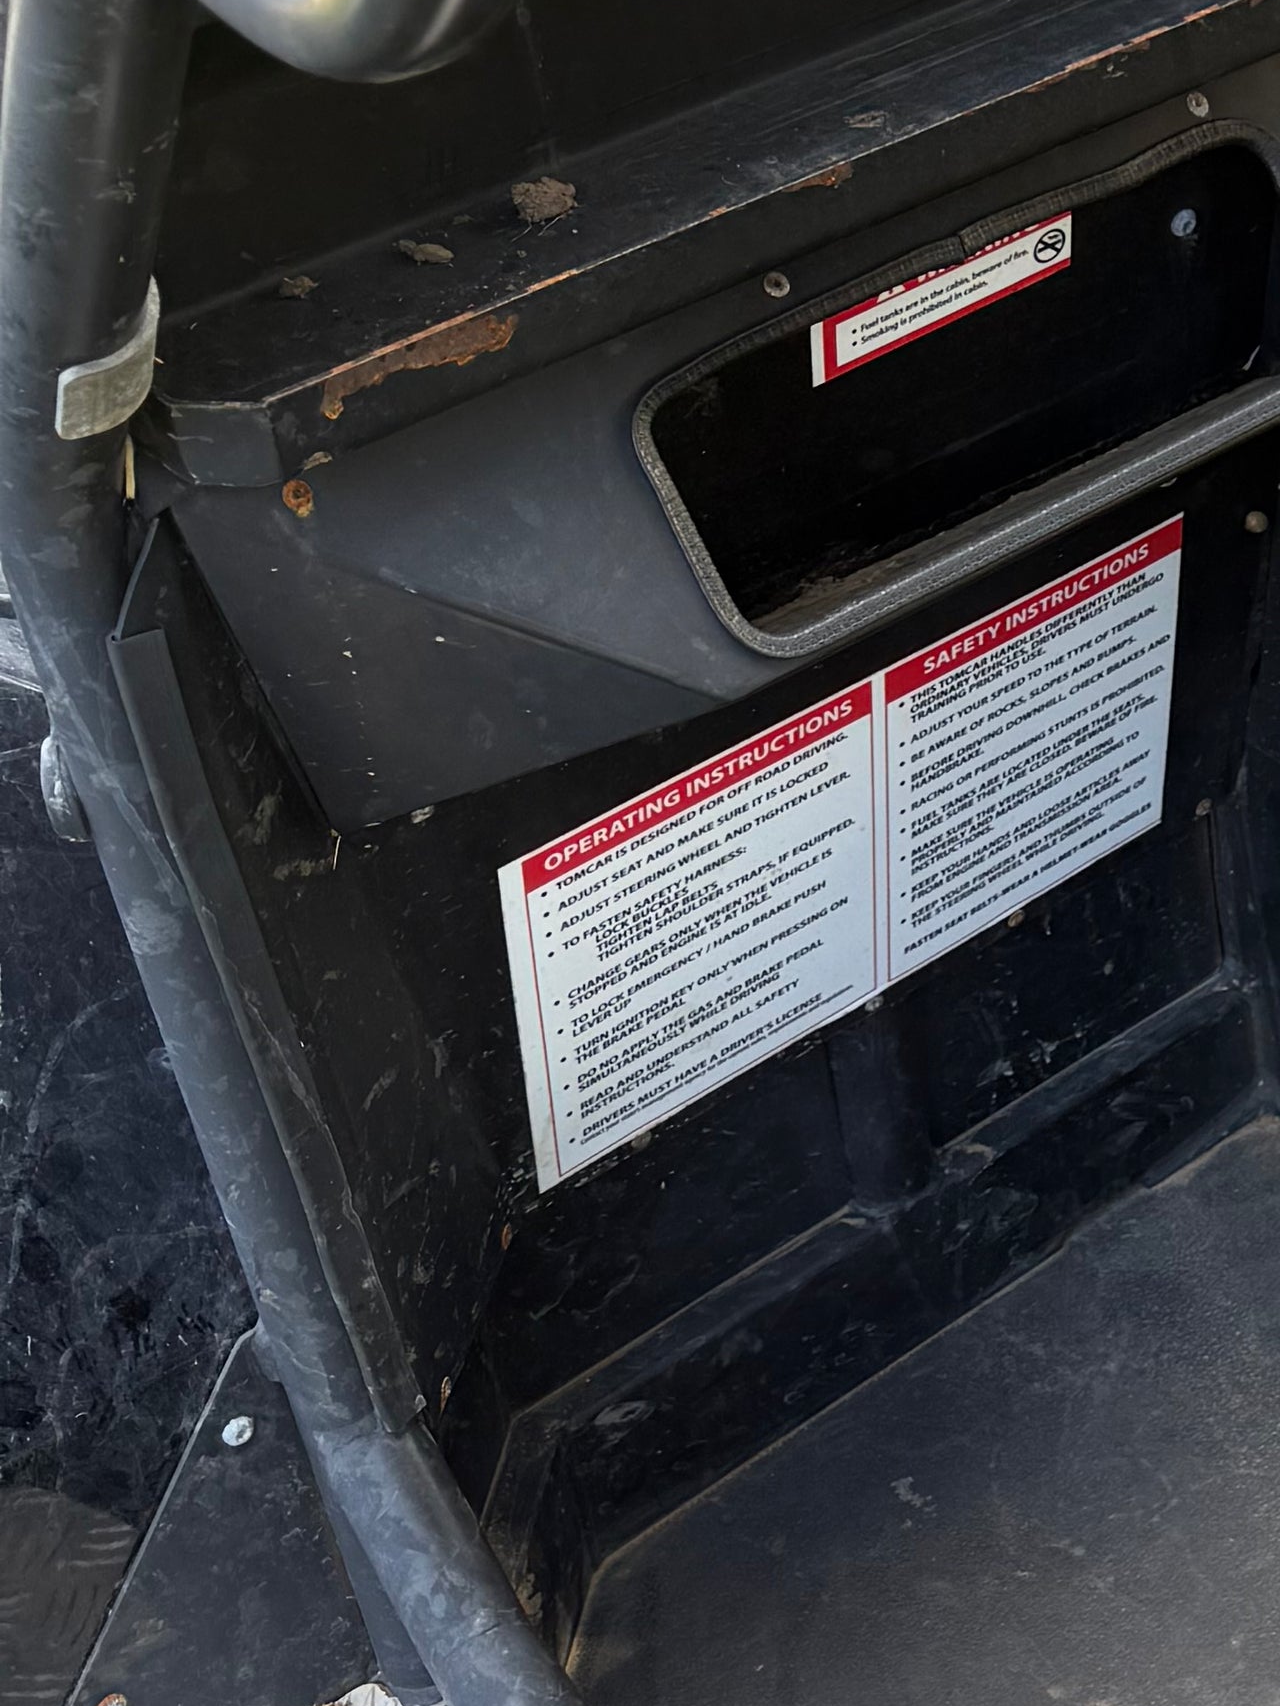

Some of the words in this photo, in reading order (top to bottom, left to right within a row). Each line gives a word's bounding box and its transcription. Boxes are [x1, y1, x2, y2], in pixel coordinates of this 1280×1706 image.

[860, 316, 879, 332] Fuel
[879, 307, 903, 323] tanks
[904, 300, 918, 311] are
[919, 295, 929, 304] in
[929, 288, 944, 299] the
[971, 260, 1002, 280] beware
[1002, 253, 1012, 265] of
[860, 321, 899, 345] Smoking
[899, 317, 907, 326] is
[908, 294, 953, 323] prohibited
[953, 291, 962, 300] in
[909, 675, 970, 713] ORDINARY
[1030, 619, 1077, 650] DRIVERS
[1078, 600, 1110, 624] MUST
[1111, 571, 1164, 606] UNDERGO
[910, 683, 937, 703] THIS
[938, 656, 987, 688] TOMCAR
[989, 627, 1043, 662] HANDLES
[1044, 588, 1114, 633] DIFFERENTLY
[1115, 571, 1146, 594] THAN
[910, 713, 954, 744] ADJUST
[956, 695, 988, 718] YOUR
[990, 676, 1026, 701] SPEED
[1027, 666, 1042, 680] TO
[1043, 654, 1064, 671] THE
[1066, 638, 1092, 659] TYPE
[1093, 629, 1109, 644] OF
[1110, 604, 1157, 635] TERRAIN.
[923, 621, 1000, 674] SAFETY
[1005, 542, 1148, 631] INSTRUCTIONS
[910, 687, 967, 723] TRAINING
[968, 668, 1003, 693] PRIOR
[1004, 659, 1020, 673] TO
[1021, 646, 1046, 664] USE.
[910, 749, 925, 763] BE
[927, 726, 967, 754] AWARE
[969, 716, 984, 731] OF
[1029, 670, 1069, 699] SLOPES
[1070, 656, 1095, 676] AND
[1096, 635, 1136, 662] BUMPS.
[910, 752, 954, 782] BEFORE
[956, 725, 1004, 757] DRIVING
[1068, 669, 1104, 695] CHECK
[1105, 646, 1146, 675] BRAKES
[1147, 633, 1171, 652] AND
[543, 788, 680, 870] OPERATING
[685, 699, 852, 797] INSTRUCTIONS
[555, 853, 612, 890] TOMCAR
[614, 845, 627, 859] IS
[629, 810, 696, 851] DESIGNED
[698, 794, 724, 815] FOR
[726, 780, 751, 799] OFF
[753, 760, 791, 785] ROAD
[792, 731, 848, 765] DRIVING.
[557, 876, 607, 911] ADJUST
[610, 858, 642, 882] SEAT
[645, 842, 675, 864] AND
[676, 820, 713, 847] MAKE
[716, 802, 749, 826] SURE
[751, 794, 763, 807] IT
[765, 787, 777, 800] IS
[779, 761, 828, 793] LOCKED
[560, 896, 609, 931] ADJUST
[613, 862, 676, 902] STEERING
[677, 838, 720, 867] WHEEL
[724, 821, 752, 842] AND
[754, 791, 807, 826] TIGHTEN
[809, 771, 851, 797] LEVER.
[561, 935, 580, 950] TO
[582, 906, 631, 940] FASTEN
[633, 878, 681, 912] SAFETY
[684, 846, 746, 884] HARNESS:
[594, 918, 629, 943] LOCK
[631, 885, 689, 923] BUCKLES
[596, 915, 652, 952] TIGHTEN
[654, 901, 679, 921] LAP
[681, 880, 718, 906] BELTS
[597, 925, 653, 961] TIGHTEN
[655, 887, 724, 931] SHOULDER
[778, 850, 789, 864] IF
[791, 818, 855, 856] EQUIPPED.
[567, 963, 621, 999] CHANGE
[623, 938, 666, 967] GEARS
[667, 918, 701, 943] ONLY
[703, 896, 742, 923] WHEN
[743, 882, 767, 901] THE
[768, 854, 818, 887] VEHICLE
[820, 847, 832, 860] IS
[568, 970, 627, 1009] STOPPED
[629, 953, 658, 975] AND
[660, 925, 707, 957] ENGINE
[709, 918, 721, 930] IS
[723, 908, 738, 923] AT
[740, 892, 772, 913] IDLE.
[571, 1012, 589, 1027] TO
[591, 991, 624, 1016] LOCK
[626, 947, 703, 996] EMERGENCY
[705, 943, 710, 953] /
[712, 922, 750, 948] HAND
[751, 898, 791, 926] BRAKE
[793, 879, 826, 904] PUSH
[574, 1030, 609, 1055] TURN
[611, 996, 669, 1034] IGNITION
[670, 981, 694, 1001] KEY
[696, 961, 729, 986] ONLY
[730, 940, 768, 966] WHEN
[770, 906, 828, 945] PRESSING
[829, 895, 848, 911] ON
[572, 1009, 612, 1037] LEVER
[613, 997, 631, 1013] UP
[575, 1045, 599, 1064] THE
[601, 1020, 643, 1050] BRAKE
[645, 997, 685, 1025] PEDAL
[577, 1066, 597, 1083] DO
[598, 1054, 619, 1070] NO
[621, 1029, 659, 1058] APPLY
[661, 1015, 685, 1034] THE
[687, 1000, 713, 1019] GAS
[714, 983, 742, 1004] AND
[744, 960, 783, 988] BRAKE
[785, 938, 823, 964] PEDAL
[577, 1023, 686, 1092] SIMULTANEOUSLY
[688, 1000, 727, 1028] WHILE
[729, 971, 780, 1005] DRIVING
[579, 1085, 614, 1110] READ
[616, 1068, 644, 1089] AND
[645, 1019, 729, 1071] UNDERSTAND
[731, 1006, 752, 1023] ALL
[754, 977, 799, 1009] SAFETY
[582, 1101, 635, 1136] DRIVERS
[637, 1078, 671, 1105] MUST
[674, 1058, 706, 1083] HAVE
[709, 1053, 718, 1063] A
[720, 1020, 774, 1057] DRIVER'S
[774, 992, 821, 1025] LICENSE
[580, 1061, 675, 1119] INSTRUCTIONS.
